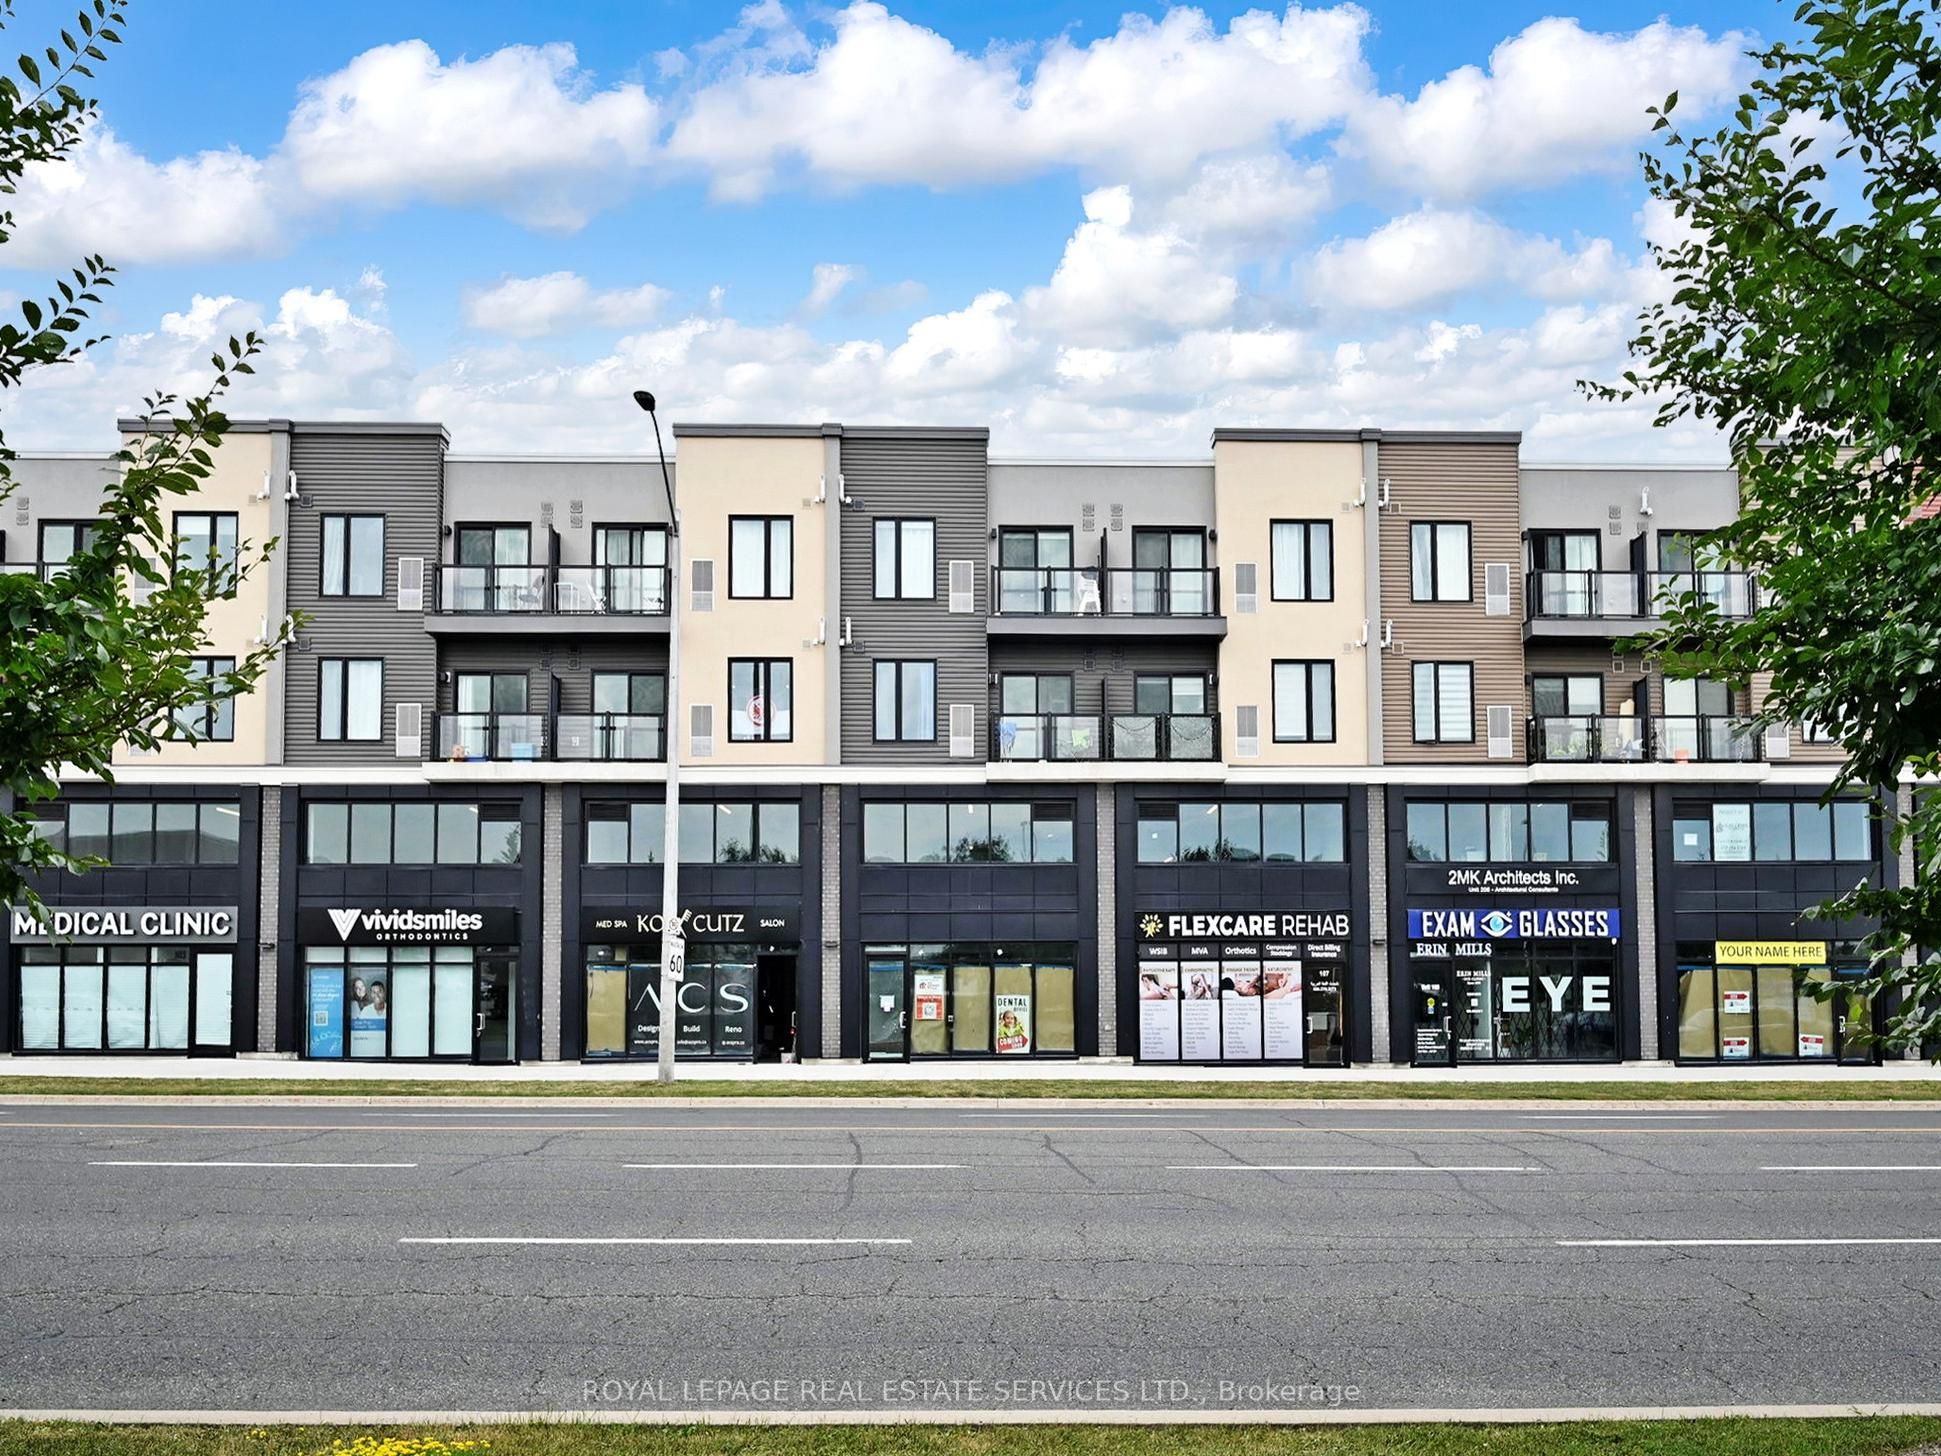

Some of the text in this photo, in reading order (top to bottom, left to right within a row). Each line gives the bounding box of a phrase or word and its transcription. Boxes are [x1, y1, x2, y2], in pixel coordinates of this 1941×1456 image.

[1448, 870, 1580, 885] 2MK Architects Inc.
[140, 911, 231, 936] CLINIC
[362, 909, 483, 931] vividsmiles
[595, 920, 612, 929] MED
[614, 920, 628, 929] SPA
[693, 914, 745, 933] CUTZ
[760, 918, 785, 928] SALON
[1168, 914, 1350, 937] FLEXCARE REHAB
[1422, 910, 1609, 937] EXAM GLASSES
[376, 932, 469, 941] ORTHODONTICS
[1224, 946, 1257, 956] Orthotics
[1416, 943, 1493, 956] ERIN MILLS
[1719, 945, 1823, 958] YOUR NAME HERE
[670, 954, 682, 974] 60
[997, 997, 1028, 1007] DENTAL
[1501, 976, 1611, 1013] EYE
[683, 1025, 701, 1033] Build
[725, 1025, 743, 1034] Reno
